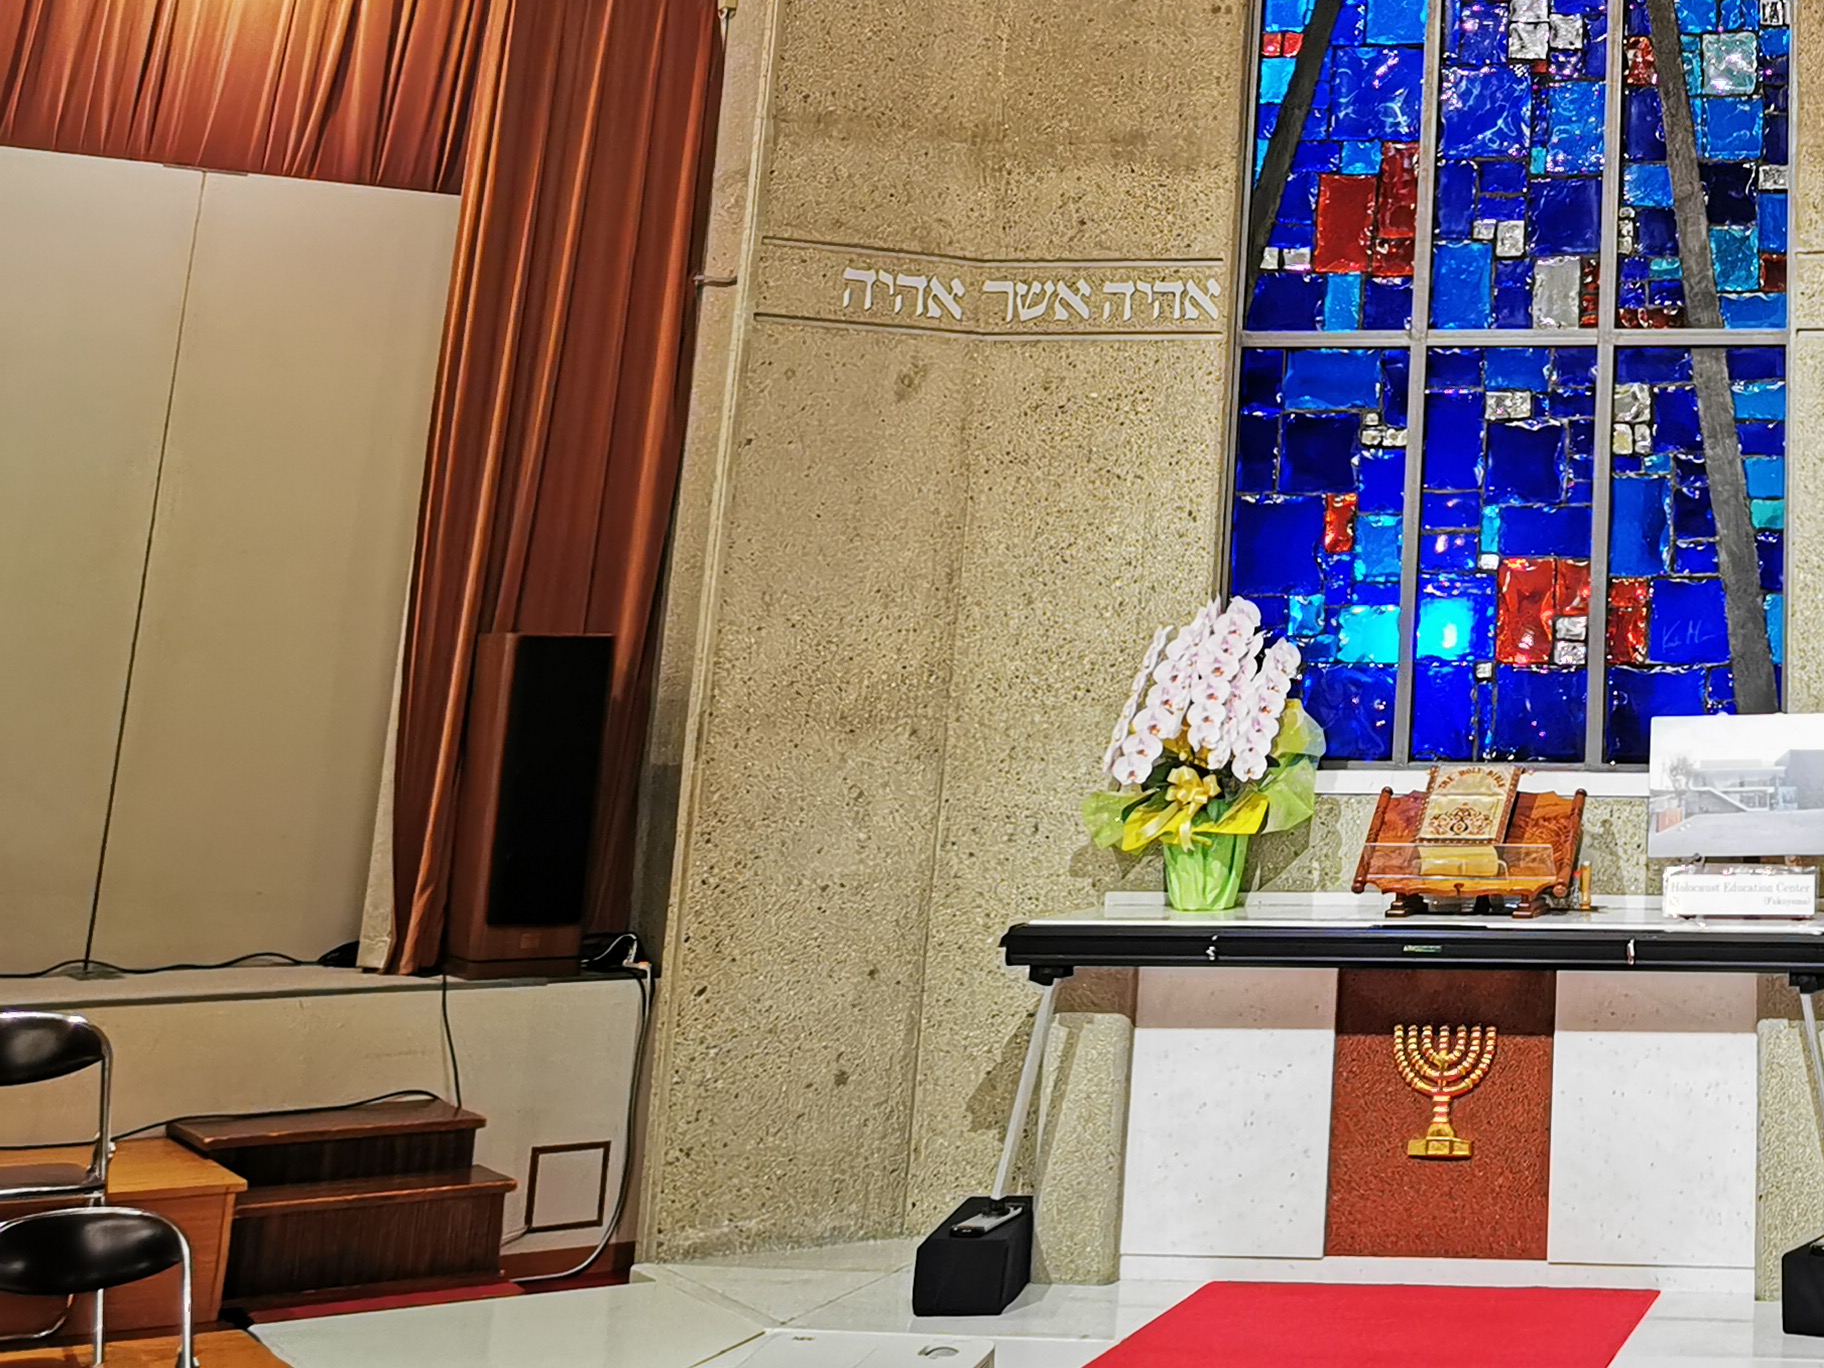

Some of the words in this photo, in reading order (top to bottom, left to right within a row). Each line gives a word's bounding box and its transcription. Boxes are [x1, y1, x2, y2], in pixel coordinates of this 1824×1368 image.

[842, 267, 965, 321] אהיה
[982, 278, 1092, 323] אשר
[1102, 278, 1221, 322] אהיה
[1670, 881, 1719, 893] Holocaust
[1723, 881, 1772, 893] Education
[1776, 881, 1810, 893] Center
